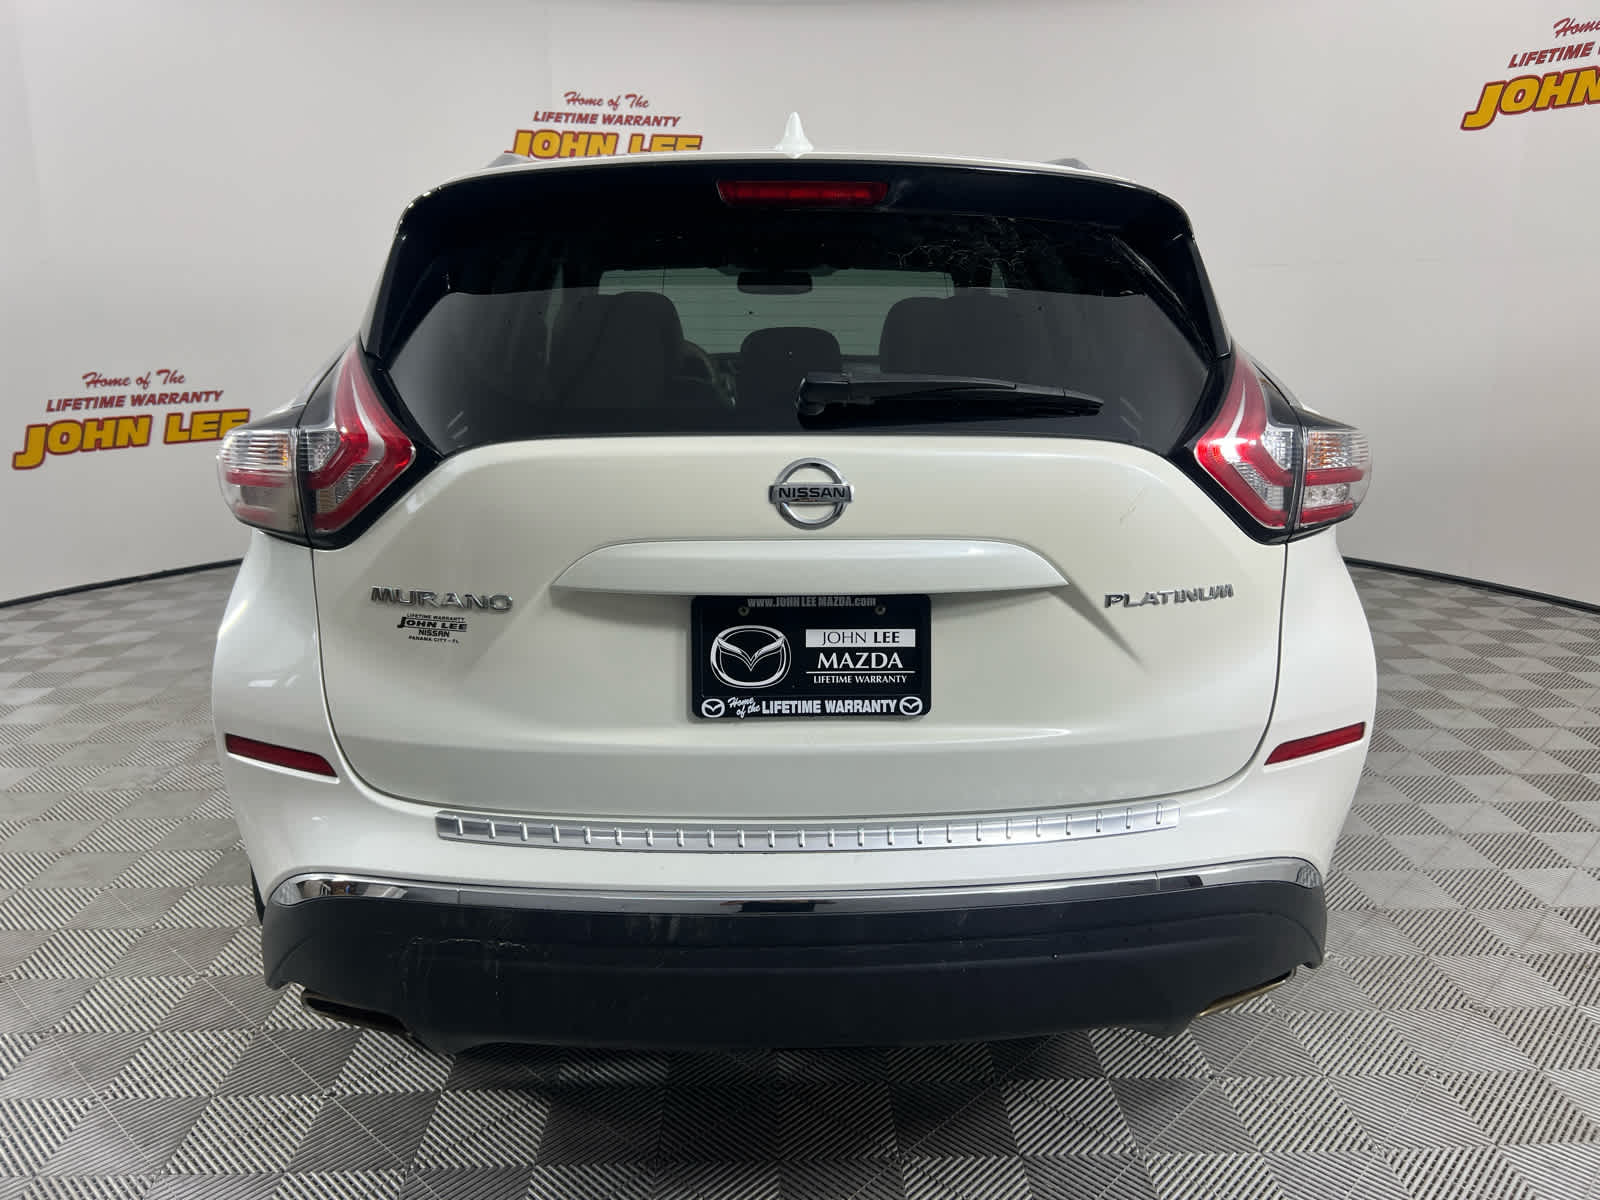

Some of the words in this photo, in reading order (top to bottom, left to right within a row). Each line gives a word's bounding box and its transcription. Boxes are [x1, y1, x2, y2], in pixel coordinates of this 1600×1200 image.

[1507, 41, 1596, 68] LIFETIME
[564, 91, 604, 108] Home
[607, 95, 621, 111] of
[625, 93, 650, 109] The
[1460, 65, 1600, 131] JOHN
[533, 110, 599, 125] LIFETIME
[602, 113, 681, 128] WARRANTY
[504, 129, 619, 160] JOHN
[82, 371, 130, 389] Home
[135, 372, 152, 390] of
[156, 369, 185, 386] The
[46, 395, 126, 412] LIFETIME
[130, 390, 224, 408] WARRANTY
[12, 415, 153, 470] JOHN
[778, 487, 846, 499] NISSAN
[370, 585, 514, 612] MURANO
[1103, 584, 1234, 609] PLATINUM
[396, 616, 437, 629] JOHN
[440, 622, 468, 631] LEE
[418, 629, 450, 638] NISSAN
[822, 631, 867, 646] JOHN
[872, 631, 900, 644] LEE
[817, 651, 904, 669] MAZDA
[813, 675, 852, 684] LIFETIME
[854, 675, 907, 684] WARRANTY
[761, 700, 821, 714] LIFETIME
[824, 699, 898, 714] WARRANTY
